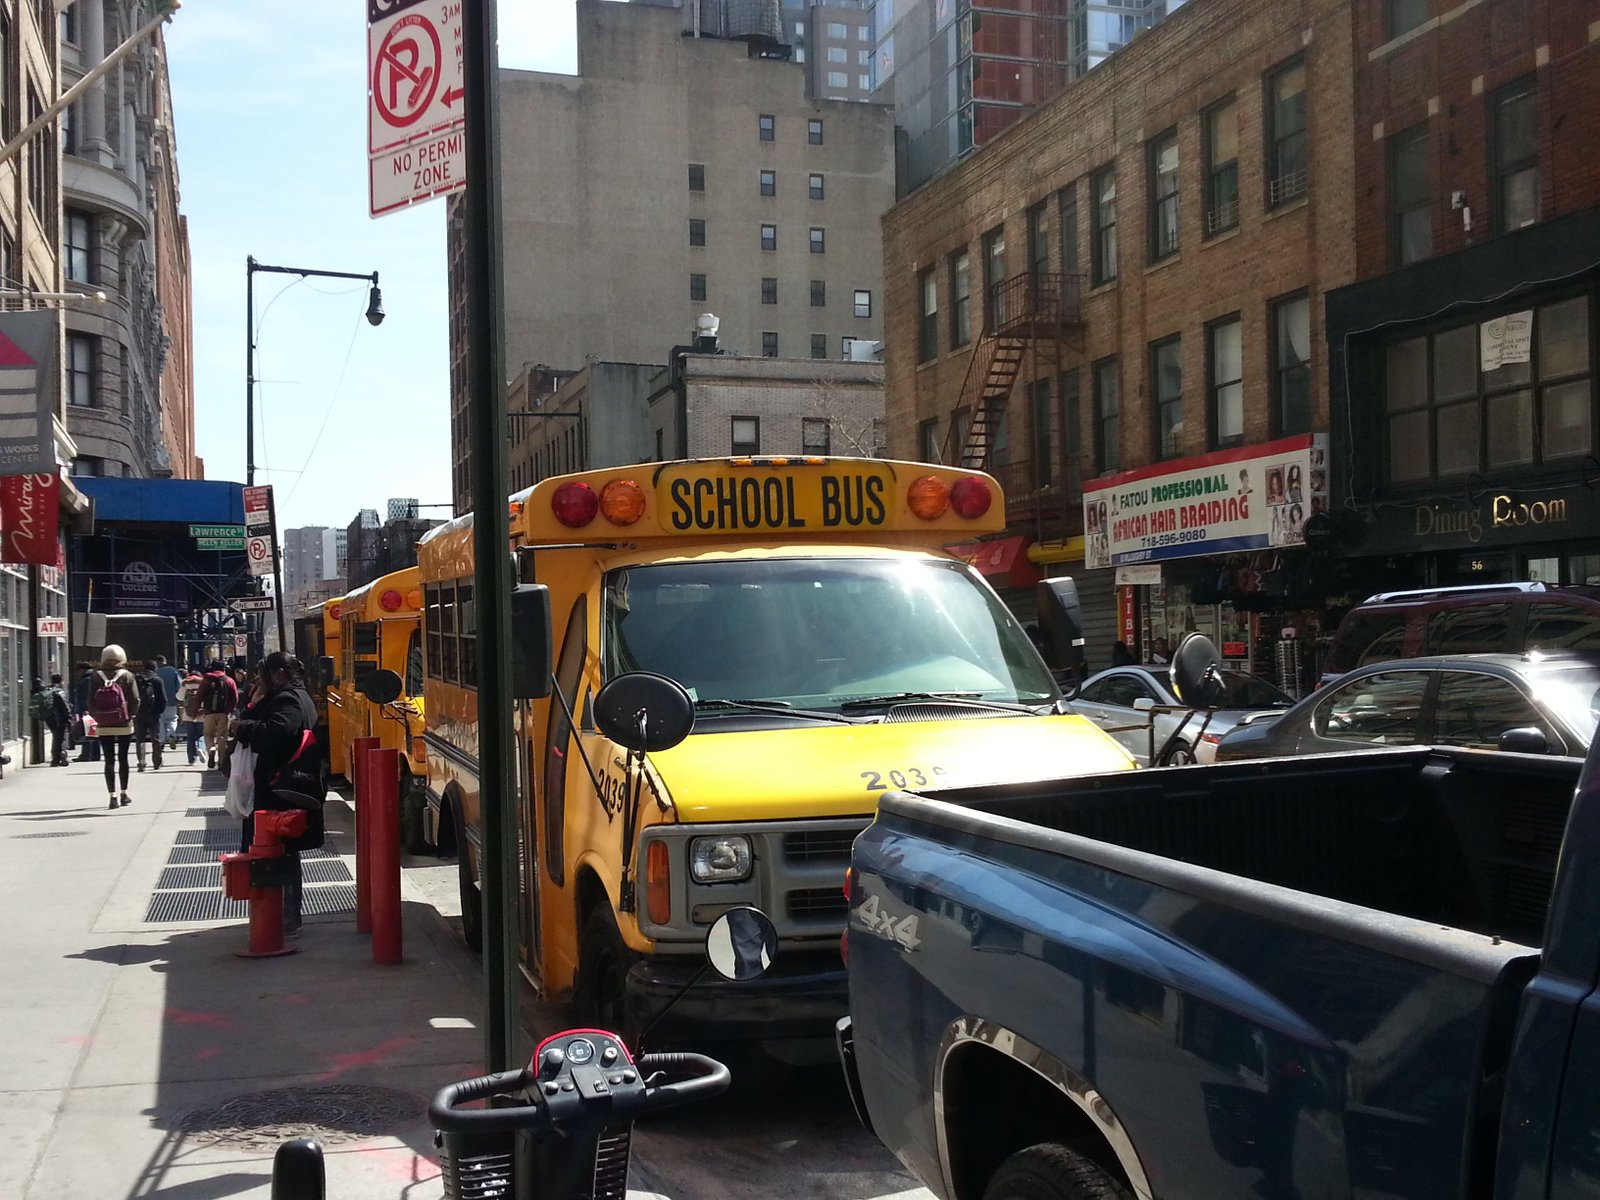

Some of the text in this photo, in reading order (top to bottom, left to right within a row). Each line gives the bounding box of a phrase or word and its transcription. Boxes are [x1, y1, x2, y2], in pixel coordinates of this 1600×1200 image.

[405, 16, 422, 25] LITTER
[393, 133, 465, 175] NO PERMI
[414, 161, 451, 190] ZONE
[5, 444, 39, 454] WORKS
[671, 475, 885, 530] SCHOOL BUS
[1120, 474, 1228, 509] FATOU PROFESSIONAL
[190, 527, 236, 536] Lawrence
[1113, 494, 1249, 543] AFRICAN HAIR BRAIDING
[1414, 495, 1568, 542] Dining Room
[1141, 529, 1206, 547] 718-596-9080
[1471, 561, 1483, 570] 56
[122, 584, 158, 592] COLLEGE
[41, 622, 64, 632] ATM
[598, 768, 626, 813] 2039
[859, 894, 921, 953] 4x4
